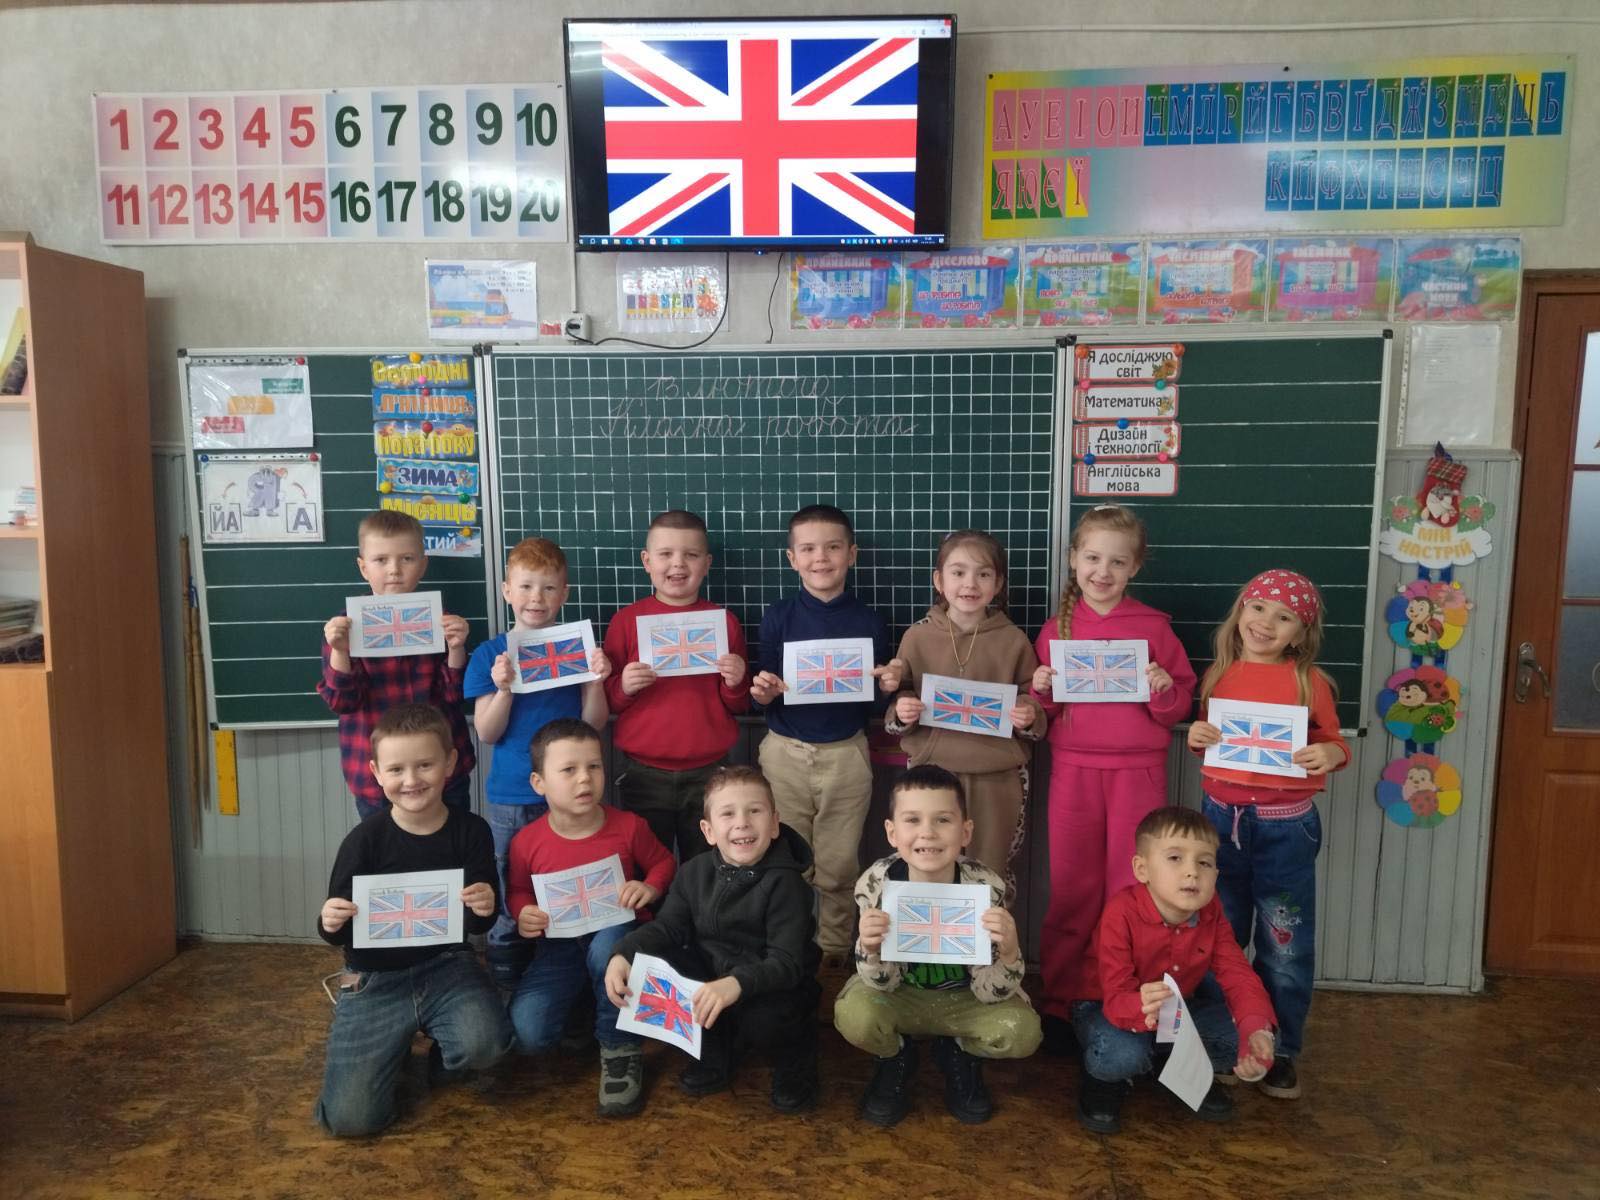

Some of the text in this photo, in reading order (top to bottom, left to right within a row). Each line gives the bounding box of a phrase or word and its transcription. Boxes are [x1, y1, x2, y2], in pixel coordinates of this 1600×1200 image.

[110, 102, 558, 151] 1 2 3 4 5 6 7 8 9 10
[107, 179, 561, 226] 11 12 13 14 15 16 17 18 19 20
[1088, 350, 1173, 364] Я досліджую
[1116, 366, 1142, 378] світ
[1085, 395, 1162, 408] Математика
[1097, 427, 1147, 443] Дизайн
[1094, 440, 1162, 454] технології
[398, 467, 459, 487] ЗИМА
[1088, 464, 1161, 477] Англійська
[1107, 482, 1140, 492] мова
[292, 507, 313, 531] А
[423, 532, 457, 549] ТИЙ
[1398, 538, 1472, 557] НАСТРІЙ
